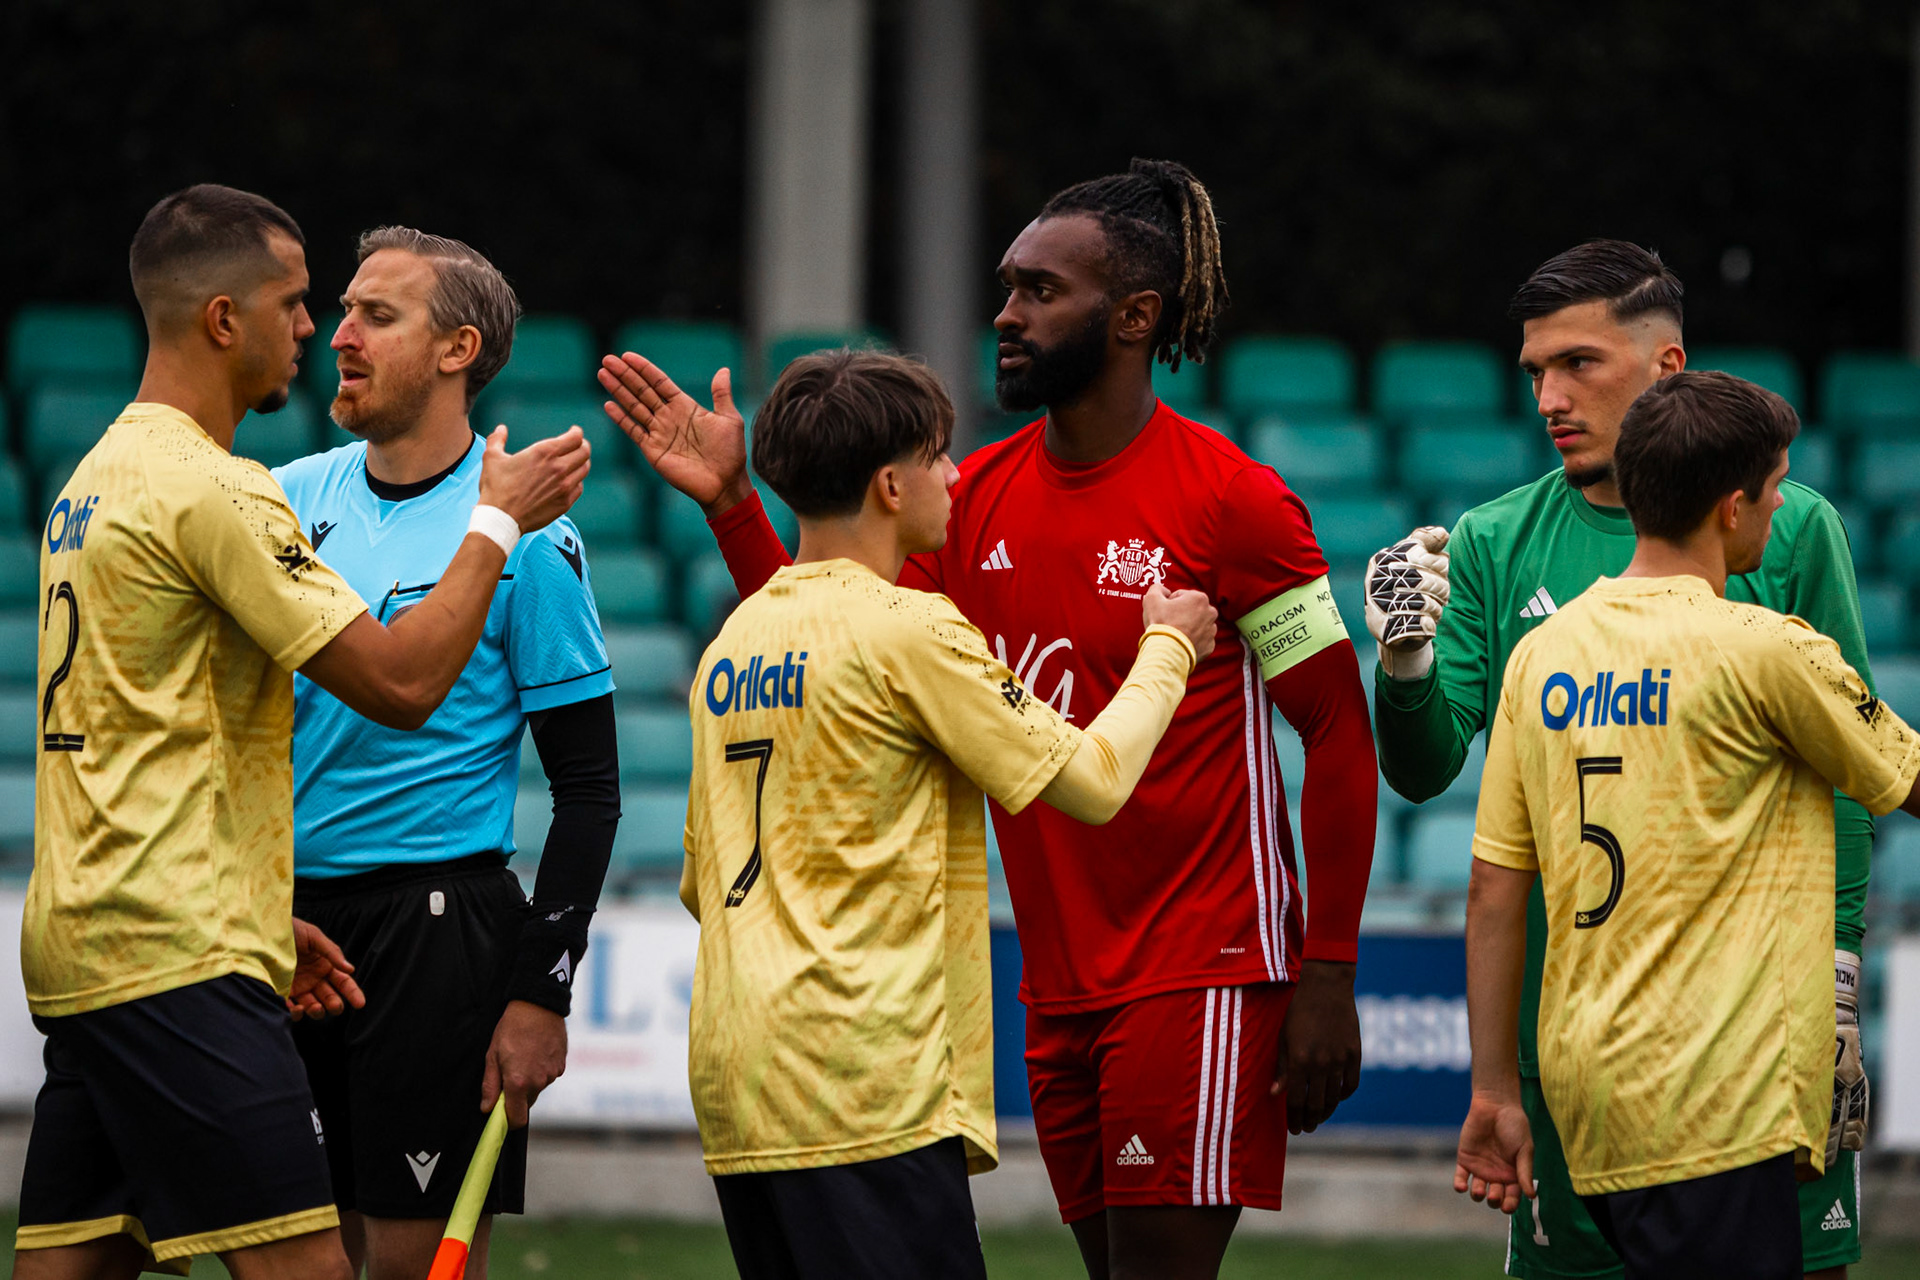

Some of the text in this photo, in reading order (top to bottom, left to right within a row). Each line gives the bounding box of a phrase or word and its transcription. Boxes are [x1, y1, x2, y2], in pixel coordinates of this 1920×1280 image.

[1126, 551, 1141, 561] SLO
[1316, 590, 1331, 603] NO
[1260, 603, 1307, 635] RACISM
[1260, 624, 1310, 660] RESPECT
[43, 580, 86, 752] 2
[706, 651, 809, 718] Orllati
[1541, 668, 1672, 732] Orllati
[724, 738, 775, 909] 7
[1574, 756, 1626, 930] 5
[1116, 1153, 1155, 1166] adidas
[1820, 1218, 1852, 1231] adidas
